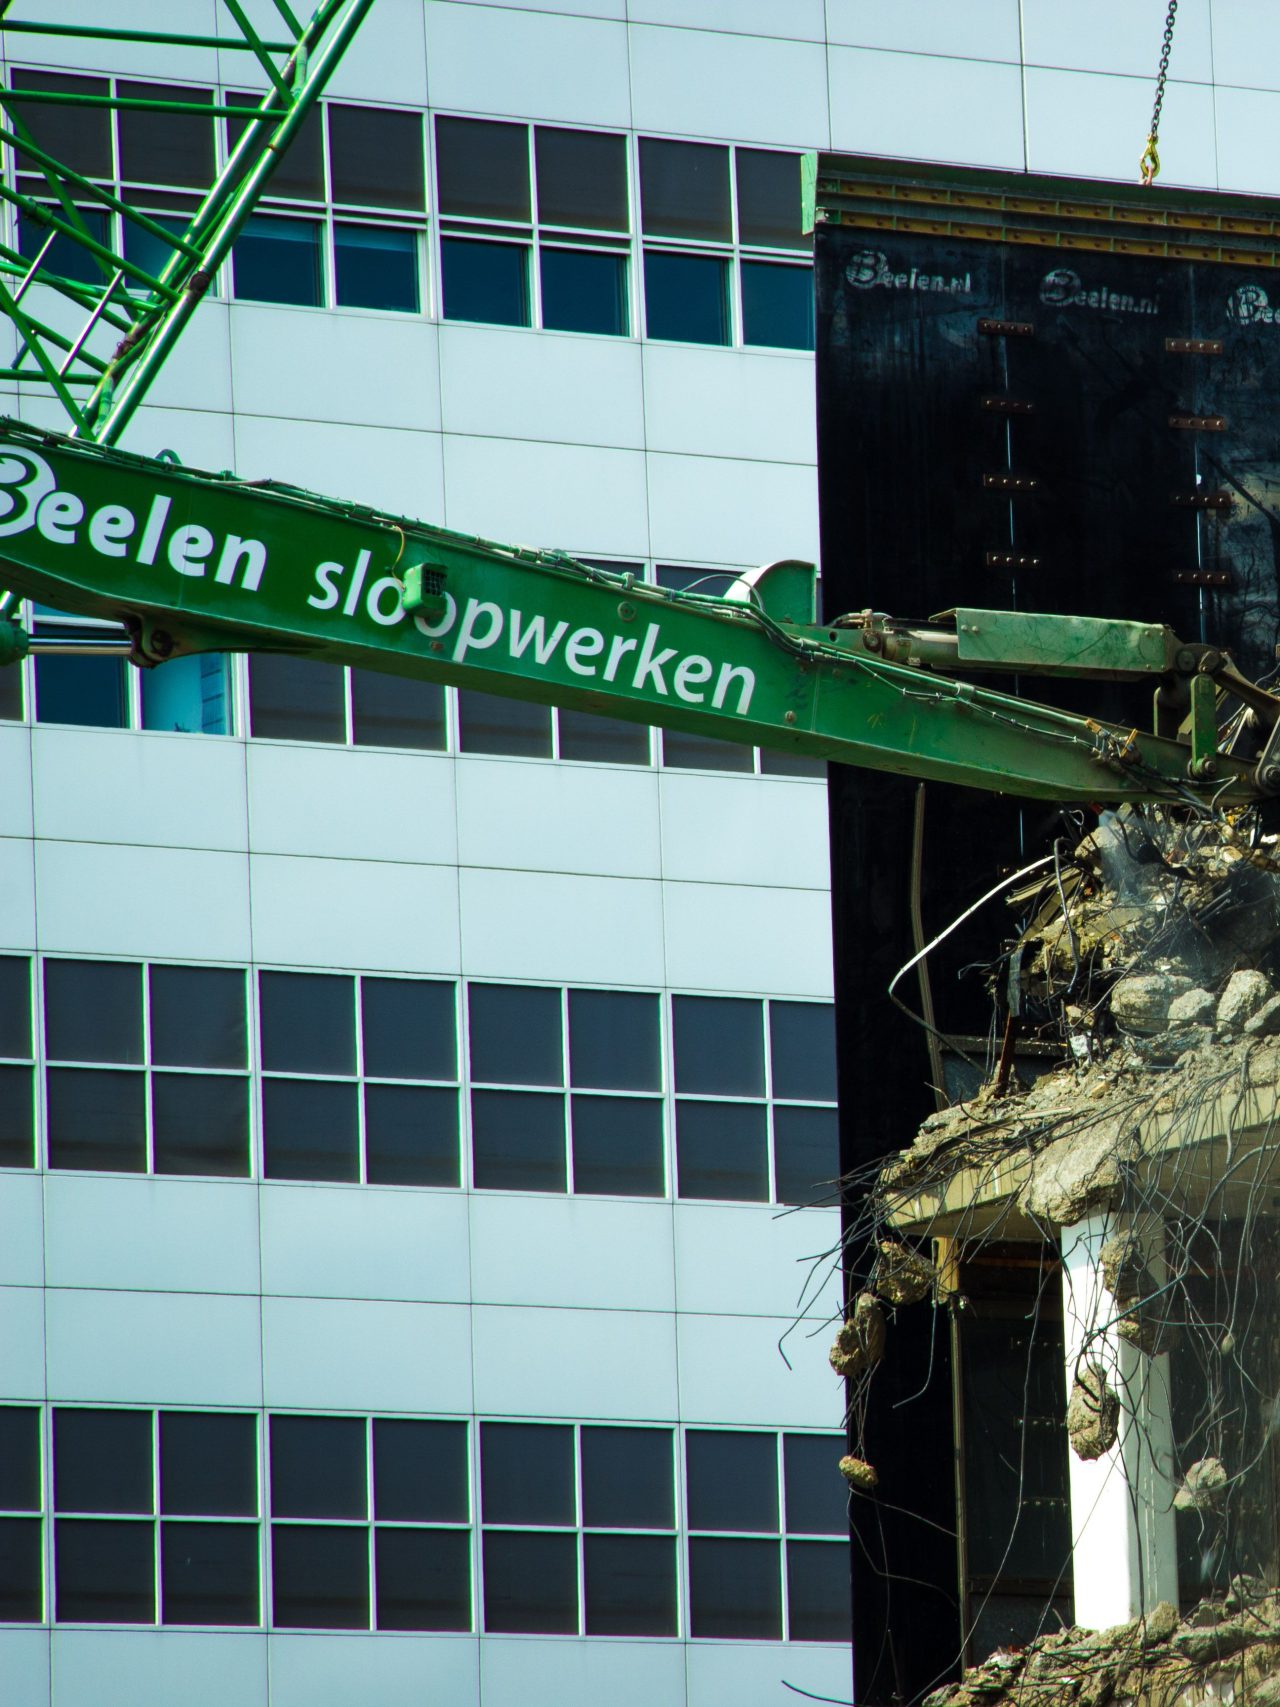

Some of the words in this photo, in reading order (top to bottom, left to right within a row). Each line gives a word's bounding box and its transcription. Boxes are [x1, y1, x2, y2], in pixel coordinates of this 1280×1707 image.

[846, 250, 972, 295] Beelen.nl
[1039, 269, 1160, 314] Beelen.nl
[306, 549, 756, 715] sloopwerken
